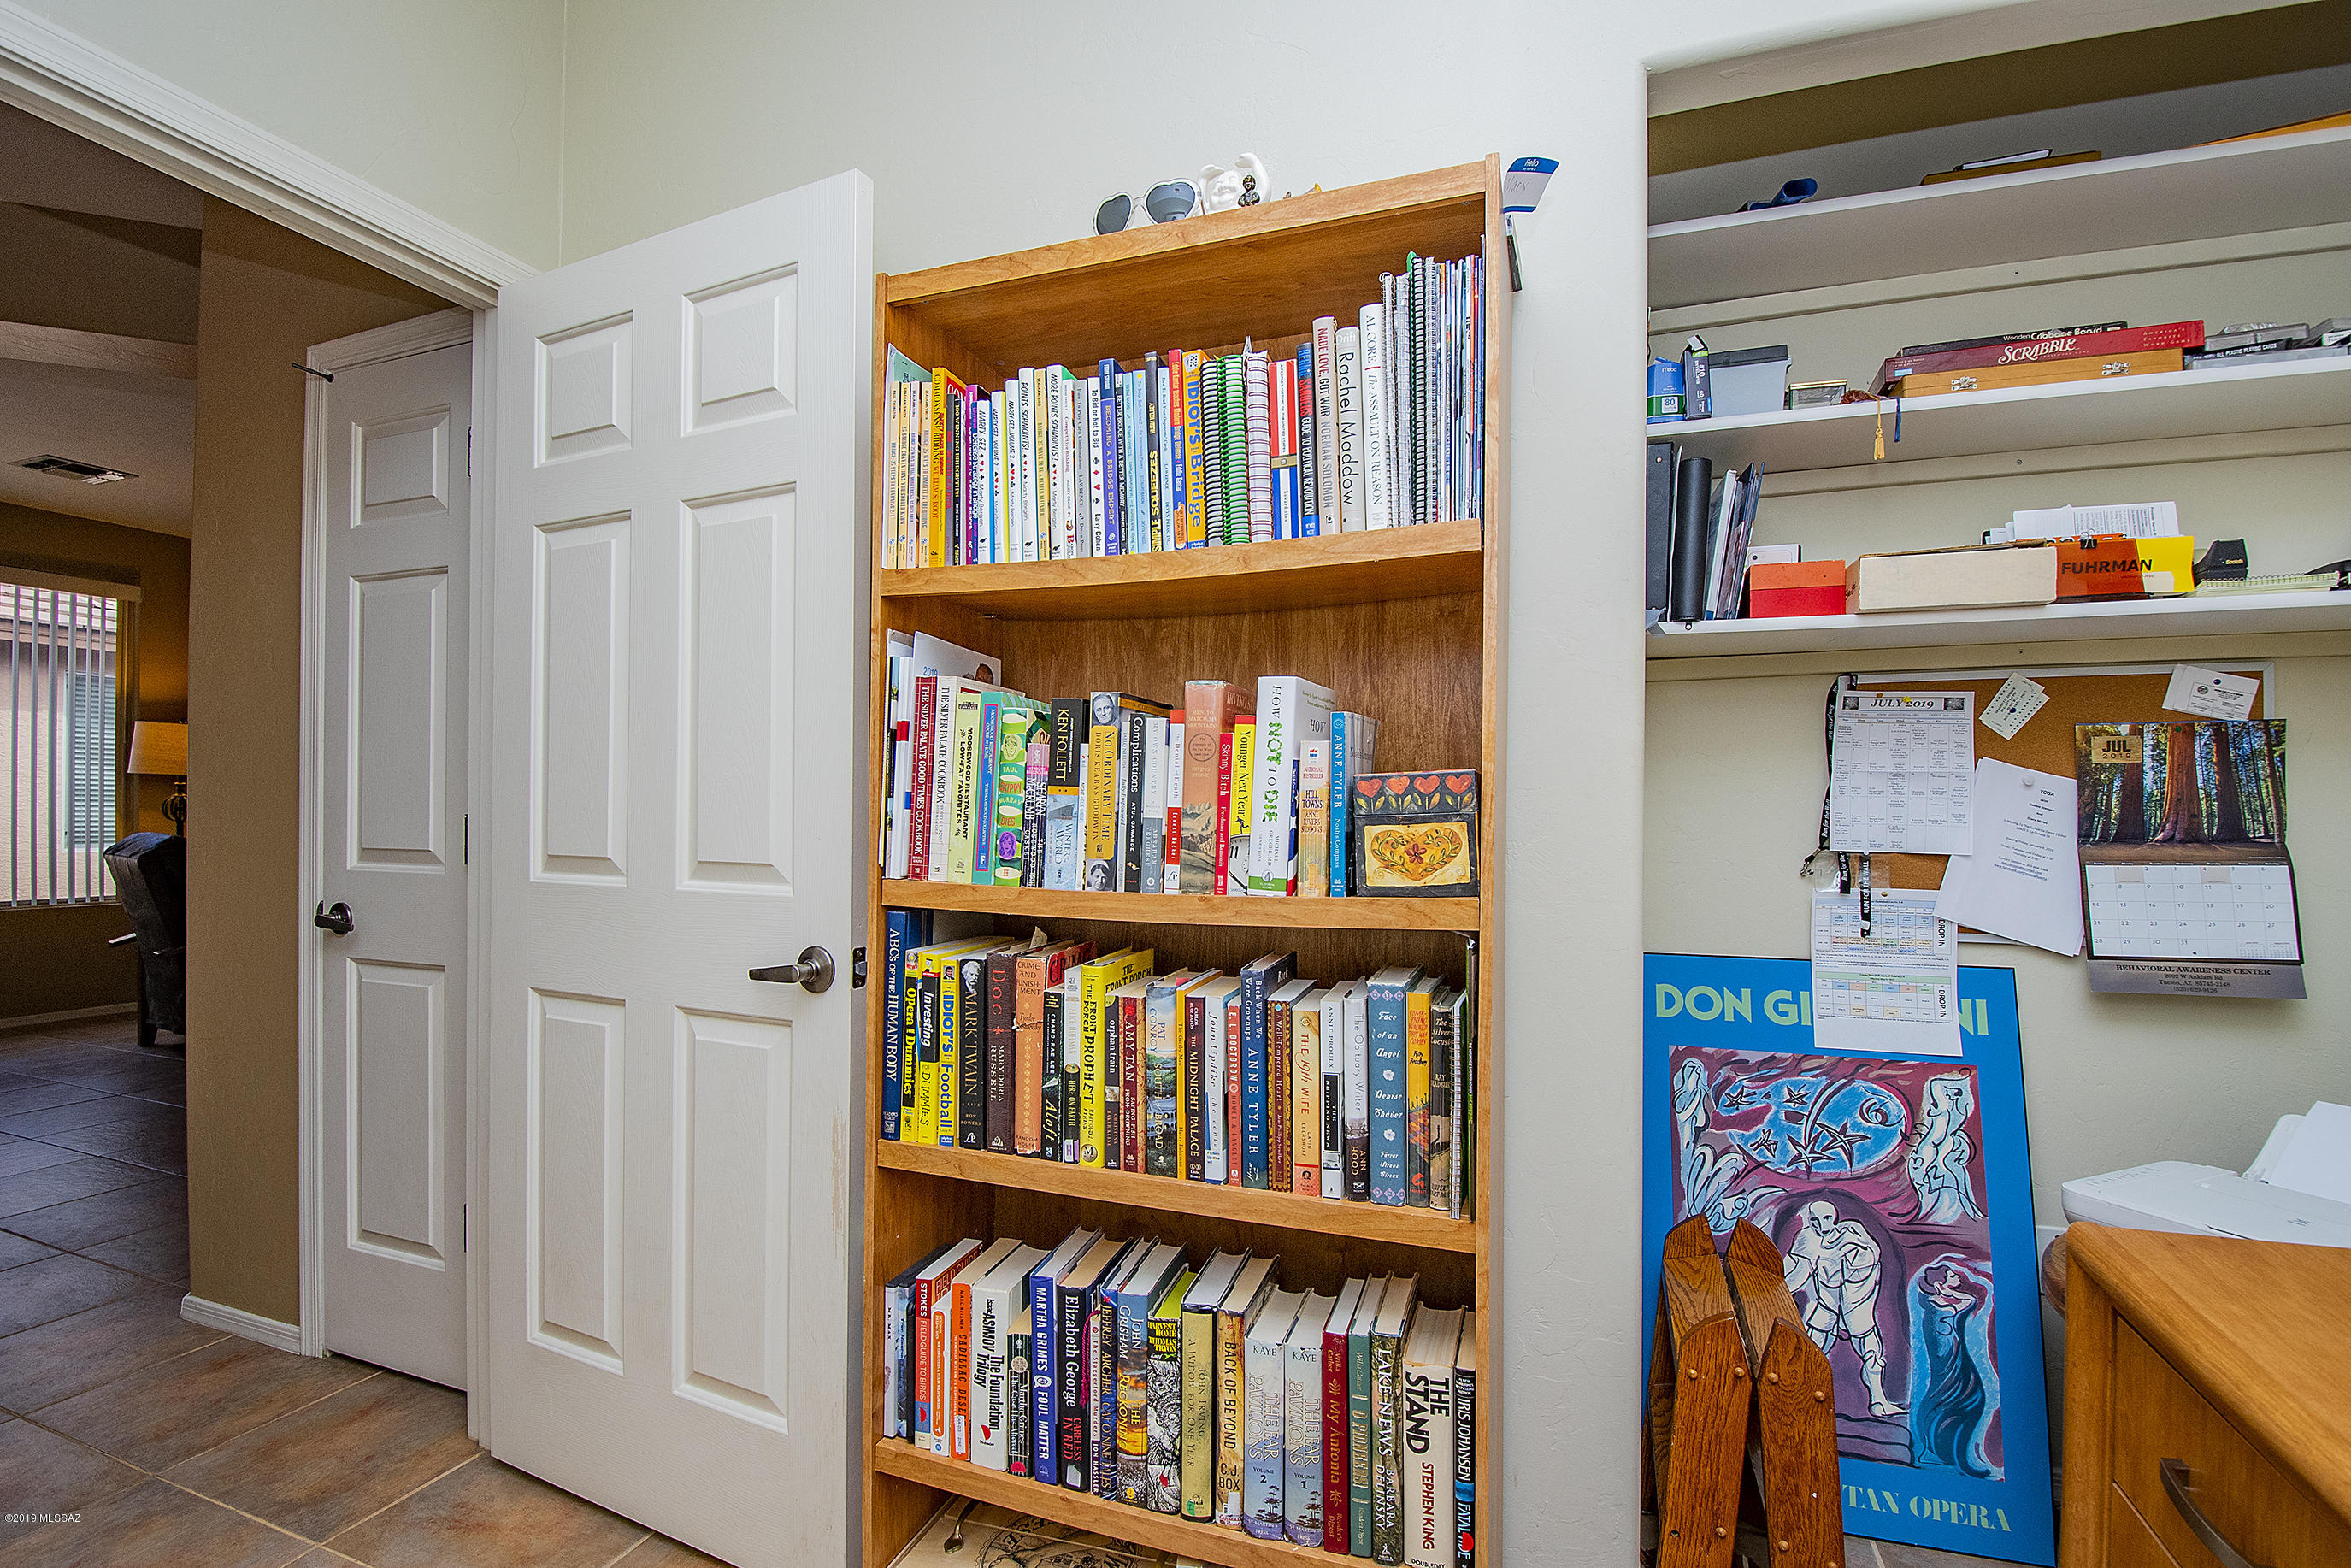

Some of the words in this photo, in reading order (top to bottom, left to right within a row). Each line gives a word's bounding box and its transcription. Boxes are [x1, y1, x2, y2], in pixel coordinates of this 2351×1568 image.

[1317, 328, 1328, 351] MADE
[1366, 316, 1375, 331] AL
[2004, 333, 2030, 341] Wooden
[2074, 326, 2102, 335] Board
[1367, 332, 1376, 363] GORE
[1998, 339, 2077, 364] SCRABBLE
[1093, 389, 1099, 398] To
[1299, 380, 1313, 416] SANDERS
[1320, 379, 1329, 394] GOT
[1339, 352, 1357, 413] Rachel
[1368, 373, 1377, 390] The
[1187, 381, 1201, 447] IDIOT'S
[1320, 397, 1330, 416] WAR
[1369, 392, 1379, 438] ASSAULT
[1301, 418, 1311, 435] GUIDE
[1321, 421, 1330, 461] NORMAN
[1302, 447, 1313, 476] POLITICAL
[1341, 422, 1359, 504] Maddow
[1370, 441, 1380, 457] ON
[1150, 451, 1158, 516] SQUEEZES
[1189, 454, 1204, 527] Bridge
[1303, 478, 1315, 515] REVOLUTION
[1323, 464, 1333, 508] SOLOMON
[1371, 461, 1382, 504] REASON
[1151, 519, 1161, 551] SIMPLE
[2061, 559, 2154, 575] FUHRMAN
[922, 667, 938, 676] 2019
[920, 703, 928, 729] SILVER
[1271, 685, 1282, 718] HOW
[1870, 699, 1902, 708] JULY
[1906, 699, 1934, 709] 2019
[1058, 709, 1069, 733] KEN
[918, 731, 928, 759] PALATE
[1056, 735, 1068, 781] FOLLETT
[1130, 717, 1143, 793] Complications
[1220, 744, 1230, 770] Skinny
[1238, 731, 1251, 770] Younger
[1266, 722, 1282, 765] NOT
[2102, 741, 2131, 752] JUL
[917, 761, 926, 783] GOOD
[1220, 774, 1229, 796] Bitch
[1238, 773, 1249, 793] Next
[1267, 766, 1277, 786] TO
[1334, 771, 1343, 808] TYLER
[916, 785, 925, 809] TIMES
[1237, 796, 1247, 816] Year
[1263, 789, 1279, 823] DIE
[915, 810, 924, 855] COOKBOOK
[1102, 811, 1112, 840] TIME
[1938, 937, 1945, 947] IN
[889, 964, 896, 975] OF
[887, 995, 898, 1047] HUMAN
[905, 988, 916, 1025] Opera
[923, 992, 934, 1046] Investing
[965, 991, 976, 1038] MARK
[1656, 983, 1752, 1024] DON
[942, 995, 954, 1052] IDIOT'S
[1125, 1021, 1134, 1051] AMY
[1300, 1034, 1309, 1053] THE
[886, 1048, 897, 1081] BODY
[904, 1036, 916, 1094] Dummies
[965, 1041, 977, 1095] TWAIN
[1083, 1035, 1096, 1104] PROPHET
[1125, 1054, 1134, 1082] TAN
[1190, 1051, 1199, 1111] MIDNIGHT
[1248, 1047, 1258, 1094] ANNE
[921, 1072, 932, 1125] DUMMIES
[940, 1064, 953, 1128] Football
[1190, 1116, 1199, 1156] PALACE
[1249, 1102, 1259, 1154] TYLER
[1036, 1288, 1047, 1328] MARTHA
[982, 1313, 995, 1353] ASIMOV
[1065, 1295, 1078, 1358] Elizabeth
[990, 1355, 1004, 1373] The
[1037, 1332, 1047, 1371] GRIMES
[1223, 1341, 1236, 1375] BACK
[920, 1367, 927, 1376] TO
[974, 1353, 990, 1388] Trilogy
[1063, 1362, 1079, 1407] George
[1224, 1378, 1236, 1394] OF
[988, 1375, 1004, 1430] Foundation
[1038, 1392, 1048, 1416] FOUL
[1327, 1400, 1341, 1420] My
[1405, 1371, 1430, 1454] STAND
[1430, 1377, 1450, 1417] THE
[1458, 1398, 1470, 1419] IRIS
[1039, 1420, 1049, 1459] MATTER
[1224, 1399, 1237, 1449] BEYOND
[1458, 1421, 1470, 1481] JOHANSEN
[1218, 1476, 1240, 1491] BOX
[1422, 1462, 1434, 1516] STEPHEN
[1909, 1496, 2011, 1531] OPERA
[1423, 1518, 1435, 1549] KING
